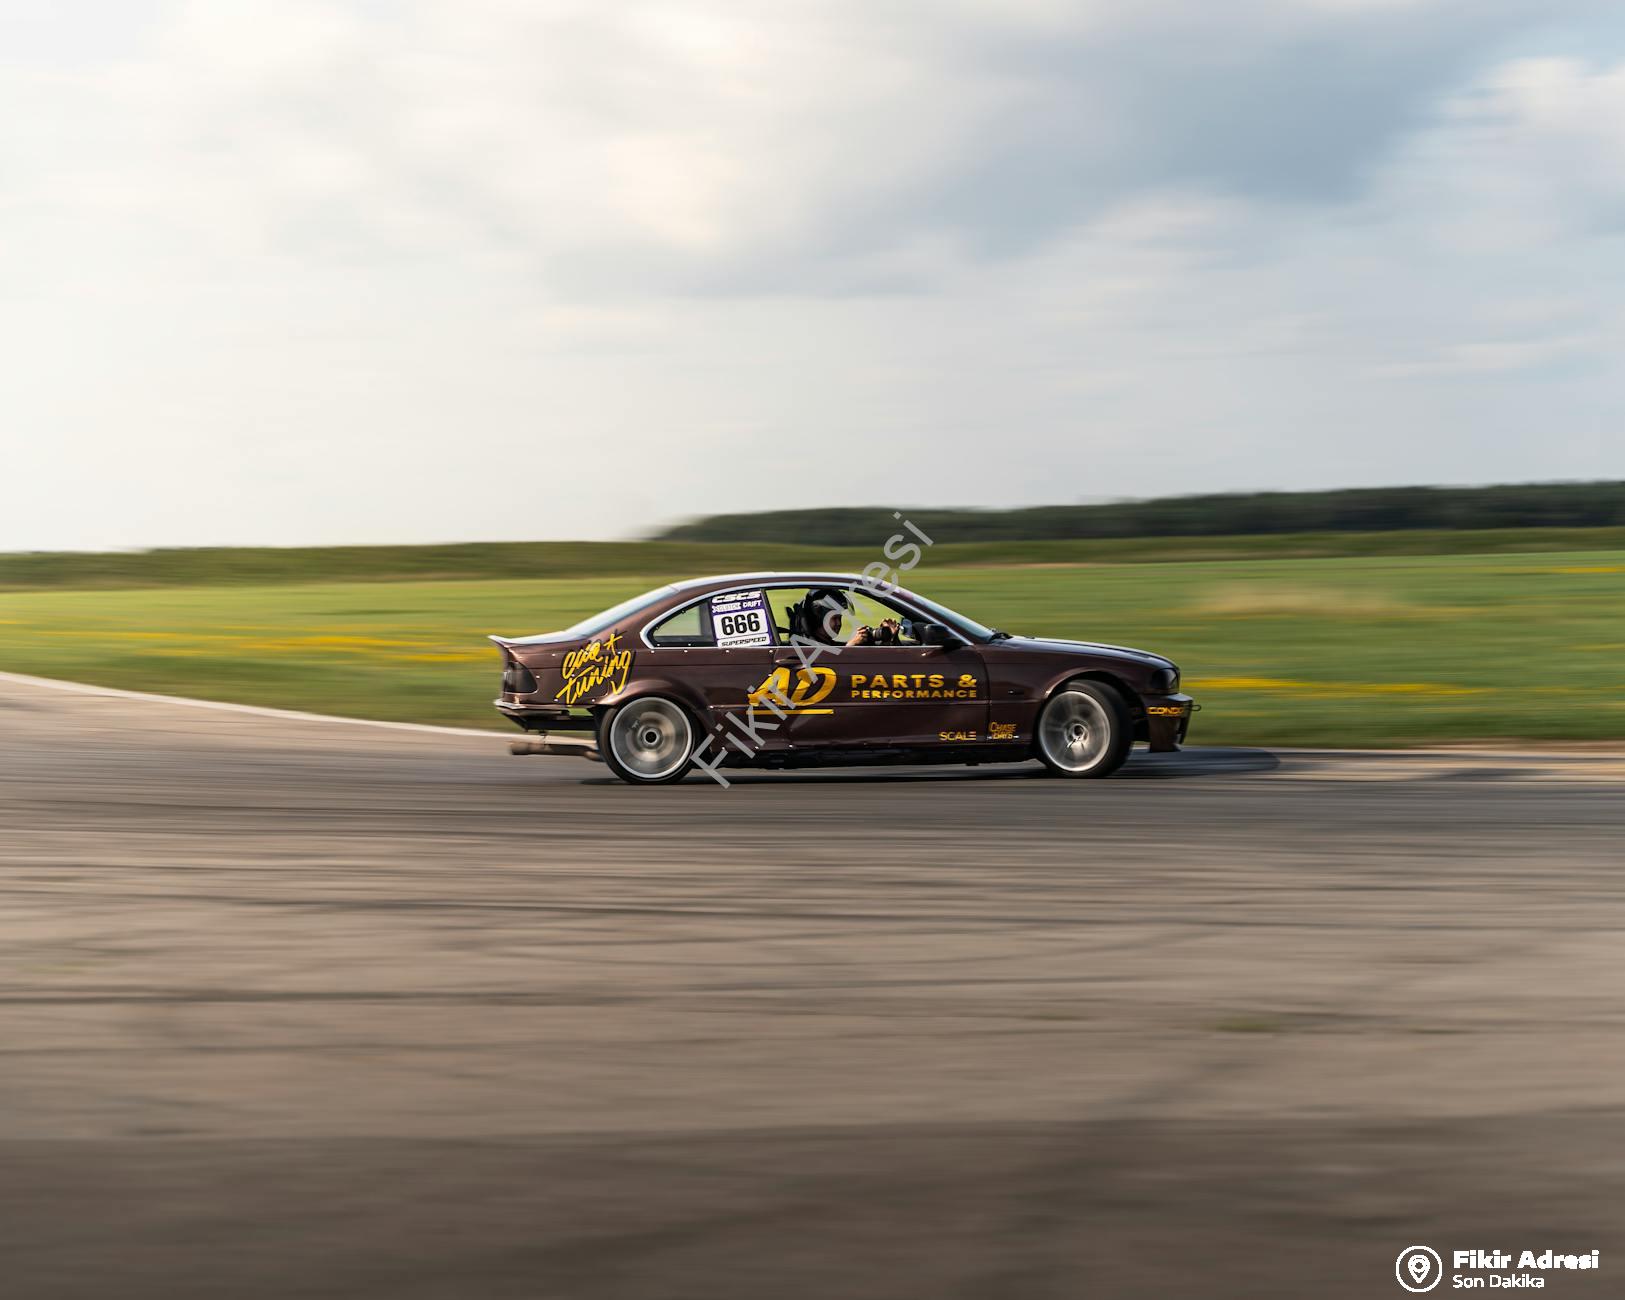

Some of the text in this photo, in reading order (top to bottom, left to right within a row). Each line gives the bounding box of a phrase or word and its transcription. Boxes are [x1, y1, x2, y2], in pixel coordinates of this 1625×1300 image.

[742, 600, 762, 609] DRIFT
[721, 612, 761, 636] 666
[721, 636, 767, 647] SUPERSPEED
[747, 666, 837, 707] AD
[851, 674, 977, 688] PARTS &
[851, 689, 977, 699] PERFORMANCE
[939, 731, 977, 741] SCALE
